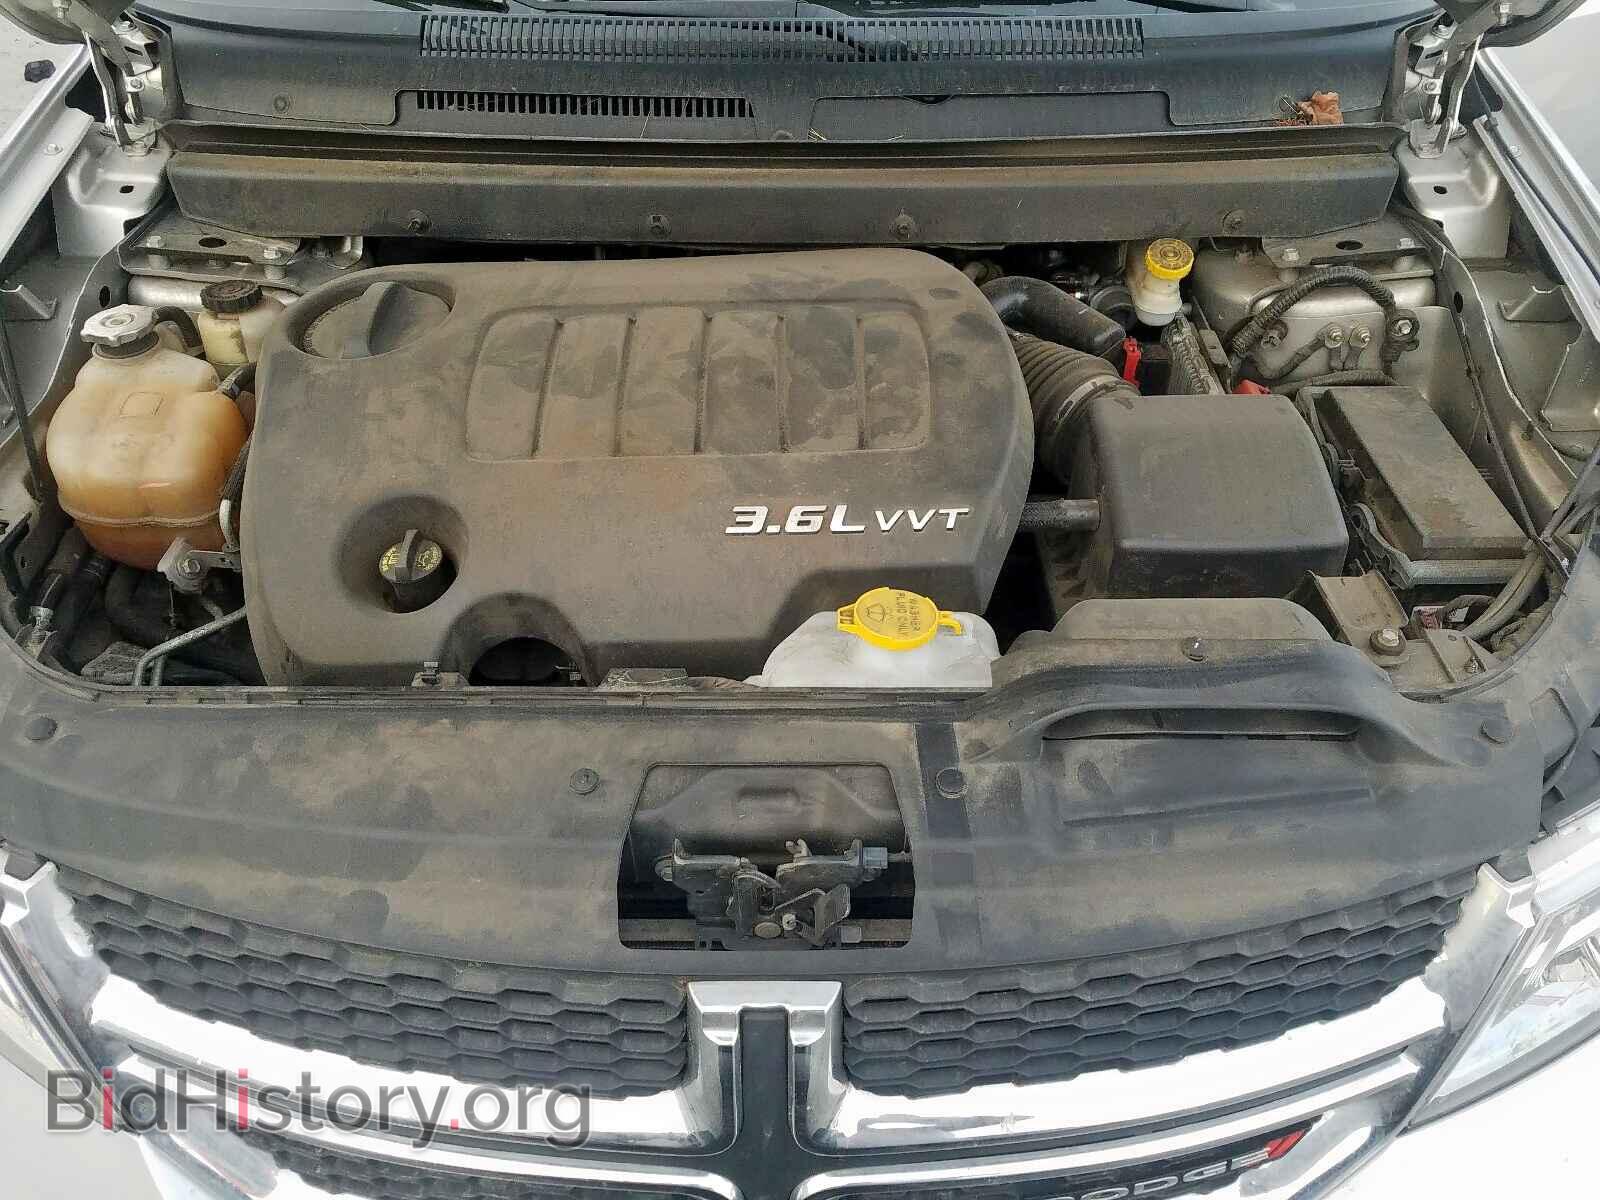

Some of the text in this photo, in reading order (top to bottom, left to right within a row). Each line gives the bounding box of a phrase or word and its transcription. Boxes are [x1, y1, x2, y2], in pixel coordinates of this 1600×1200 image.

[725, 504, 970, 535] 3.6L VVT
[1042, 1148, 1271, 1200] ODGE
